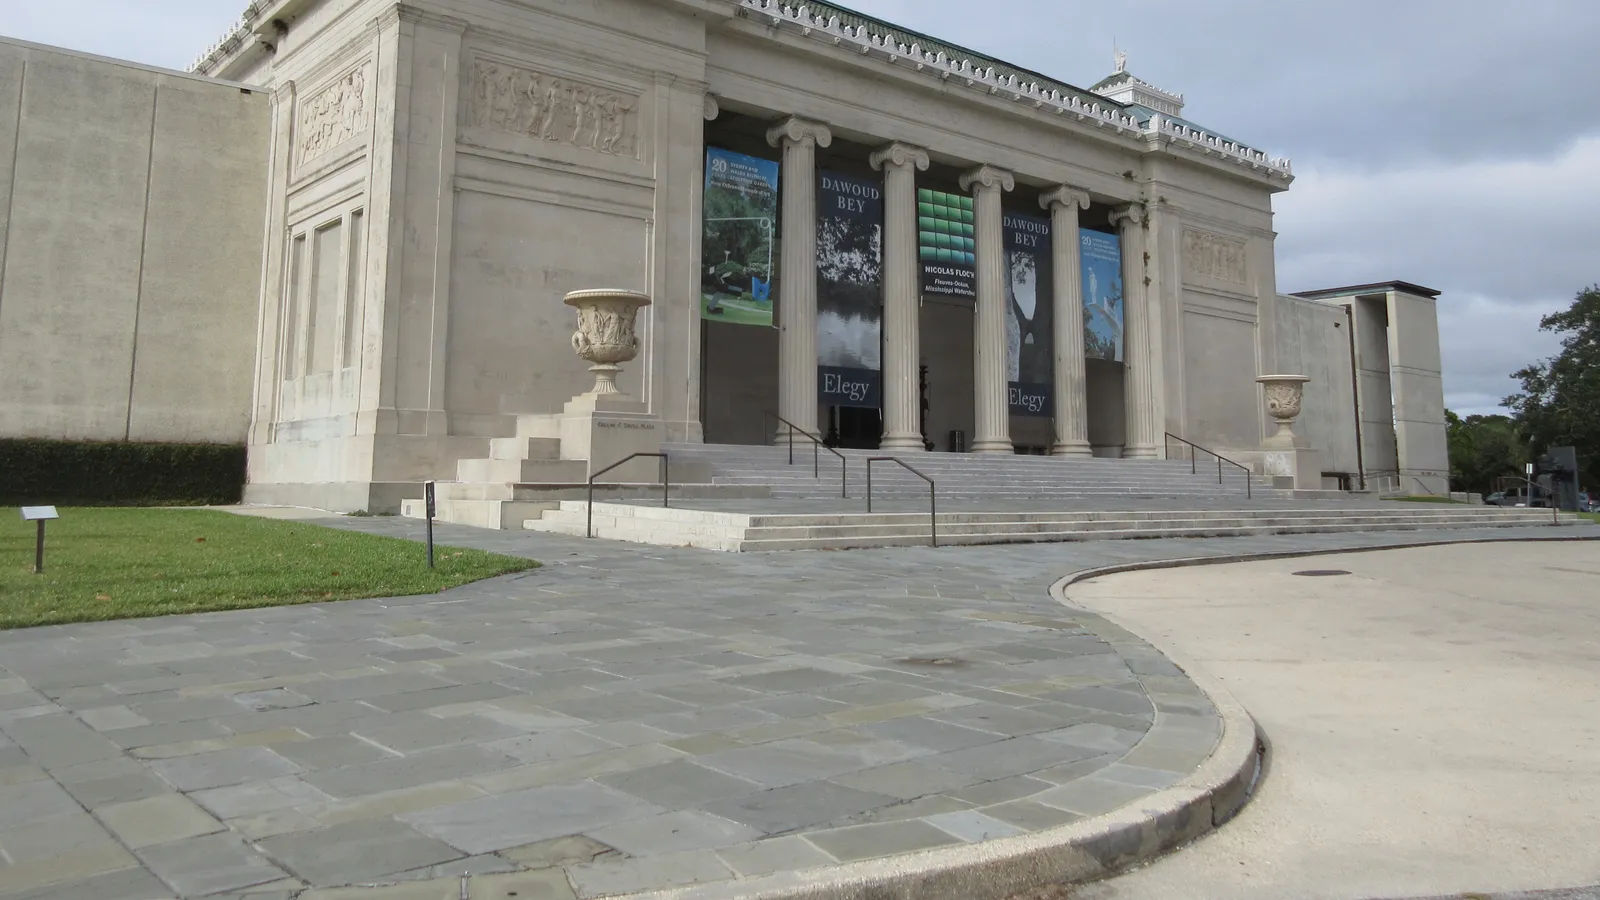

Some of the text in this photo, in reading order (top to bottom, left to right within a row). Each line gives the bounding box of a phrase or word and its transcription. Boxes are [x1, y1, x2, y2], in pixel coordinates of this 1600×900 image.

[712, 158, 726, 172] 20
[822, 176, 879, 200] DAWOUD
[838, 196, 865, 212] BEY
[1004, 216, 1048, 234] DAWOUD
[1016, 232, 1038, 246] BEY
[1082, 236, 1092, 246] 20
[925, 266, 954, 276] NICOLAS
[824, 373, 870, 401] Elegy
[1008, 388, 1045, 412] Elegy
